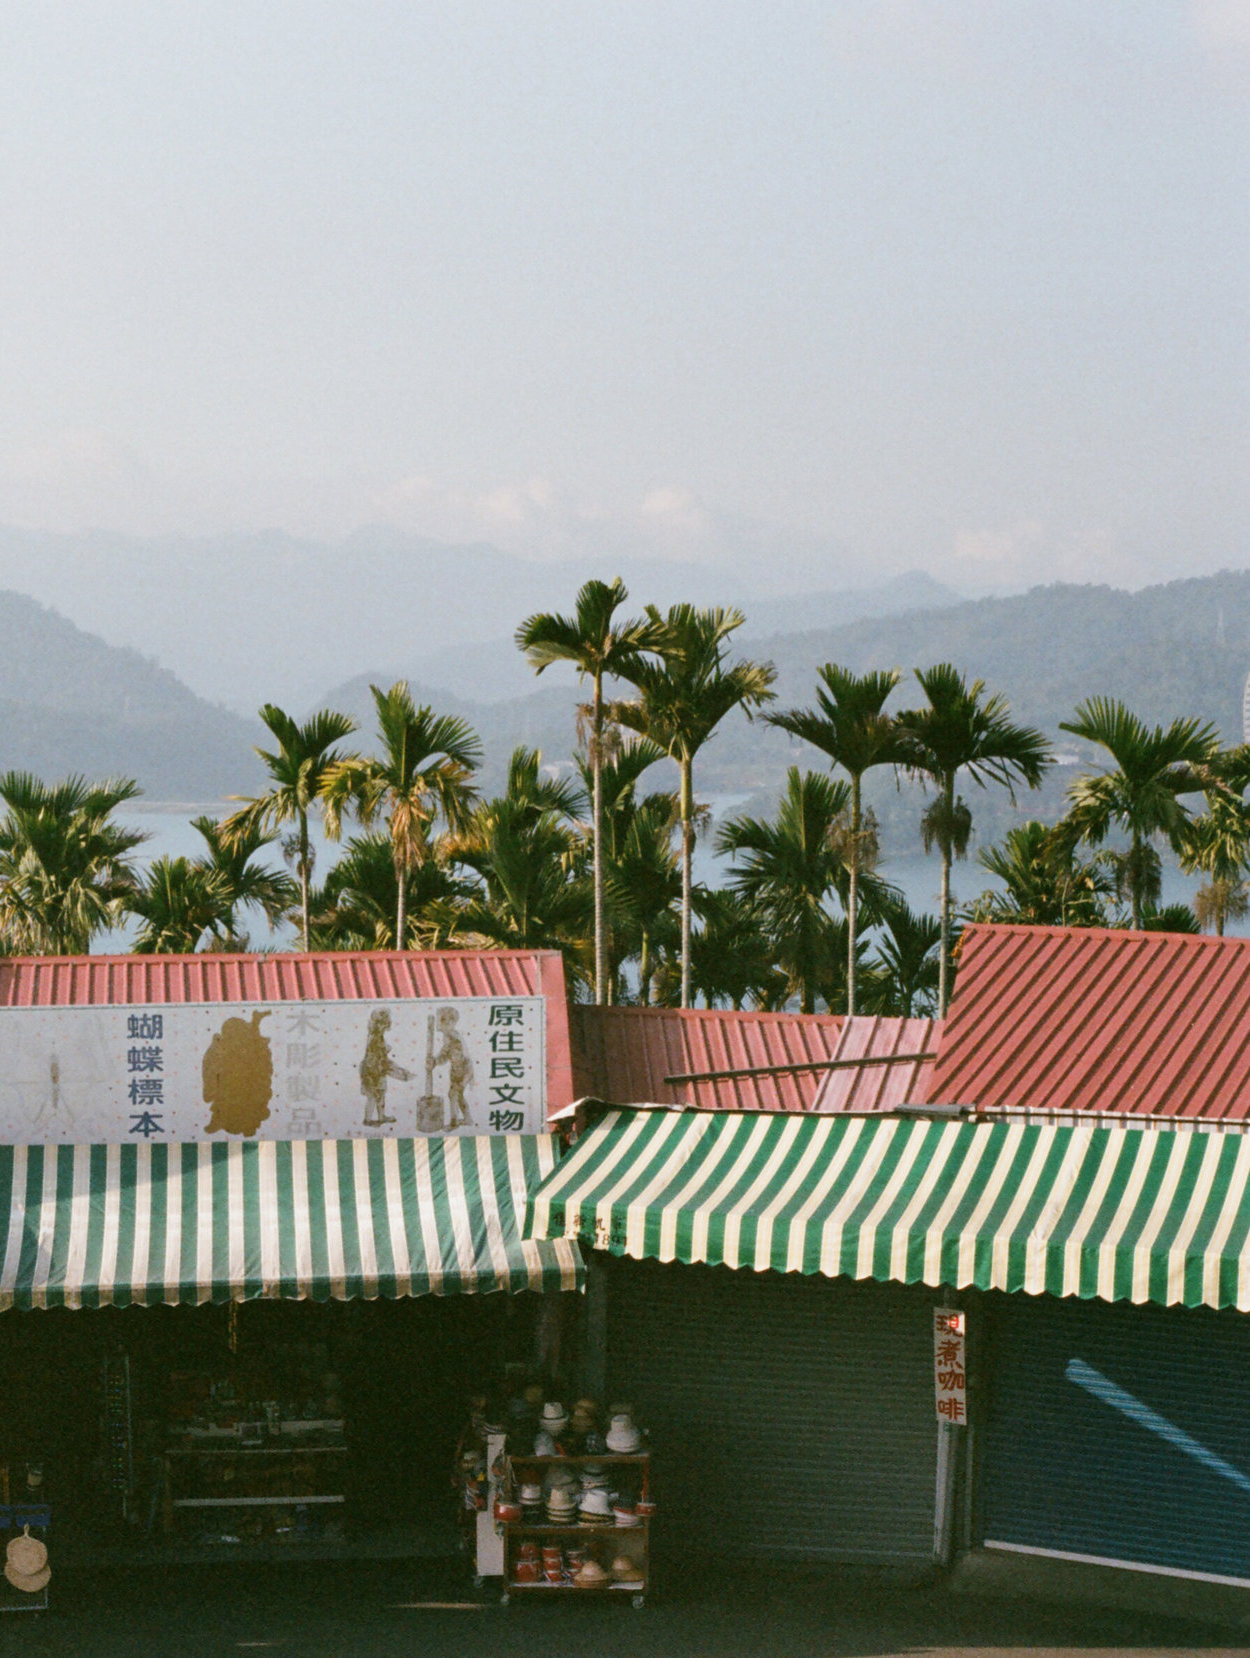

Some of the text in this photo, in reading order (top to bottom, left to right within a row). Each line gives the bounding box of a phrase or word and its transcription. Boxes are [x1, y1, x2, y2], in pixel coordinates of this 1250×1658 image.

[126, 1013, 165, 1138] 蝴蝶標本
[488, 1004, 525, 1132] 原住民文物
[934, 1313, 965, 1421] 現煮咖啡
